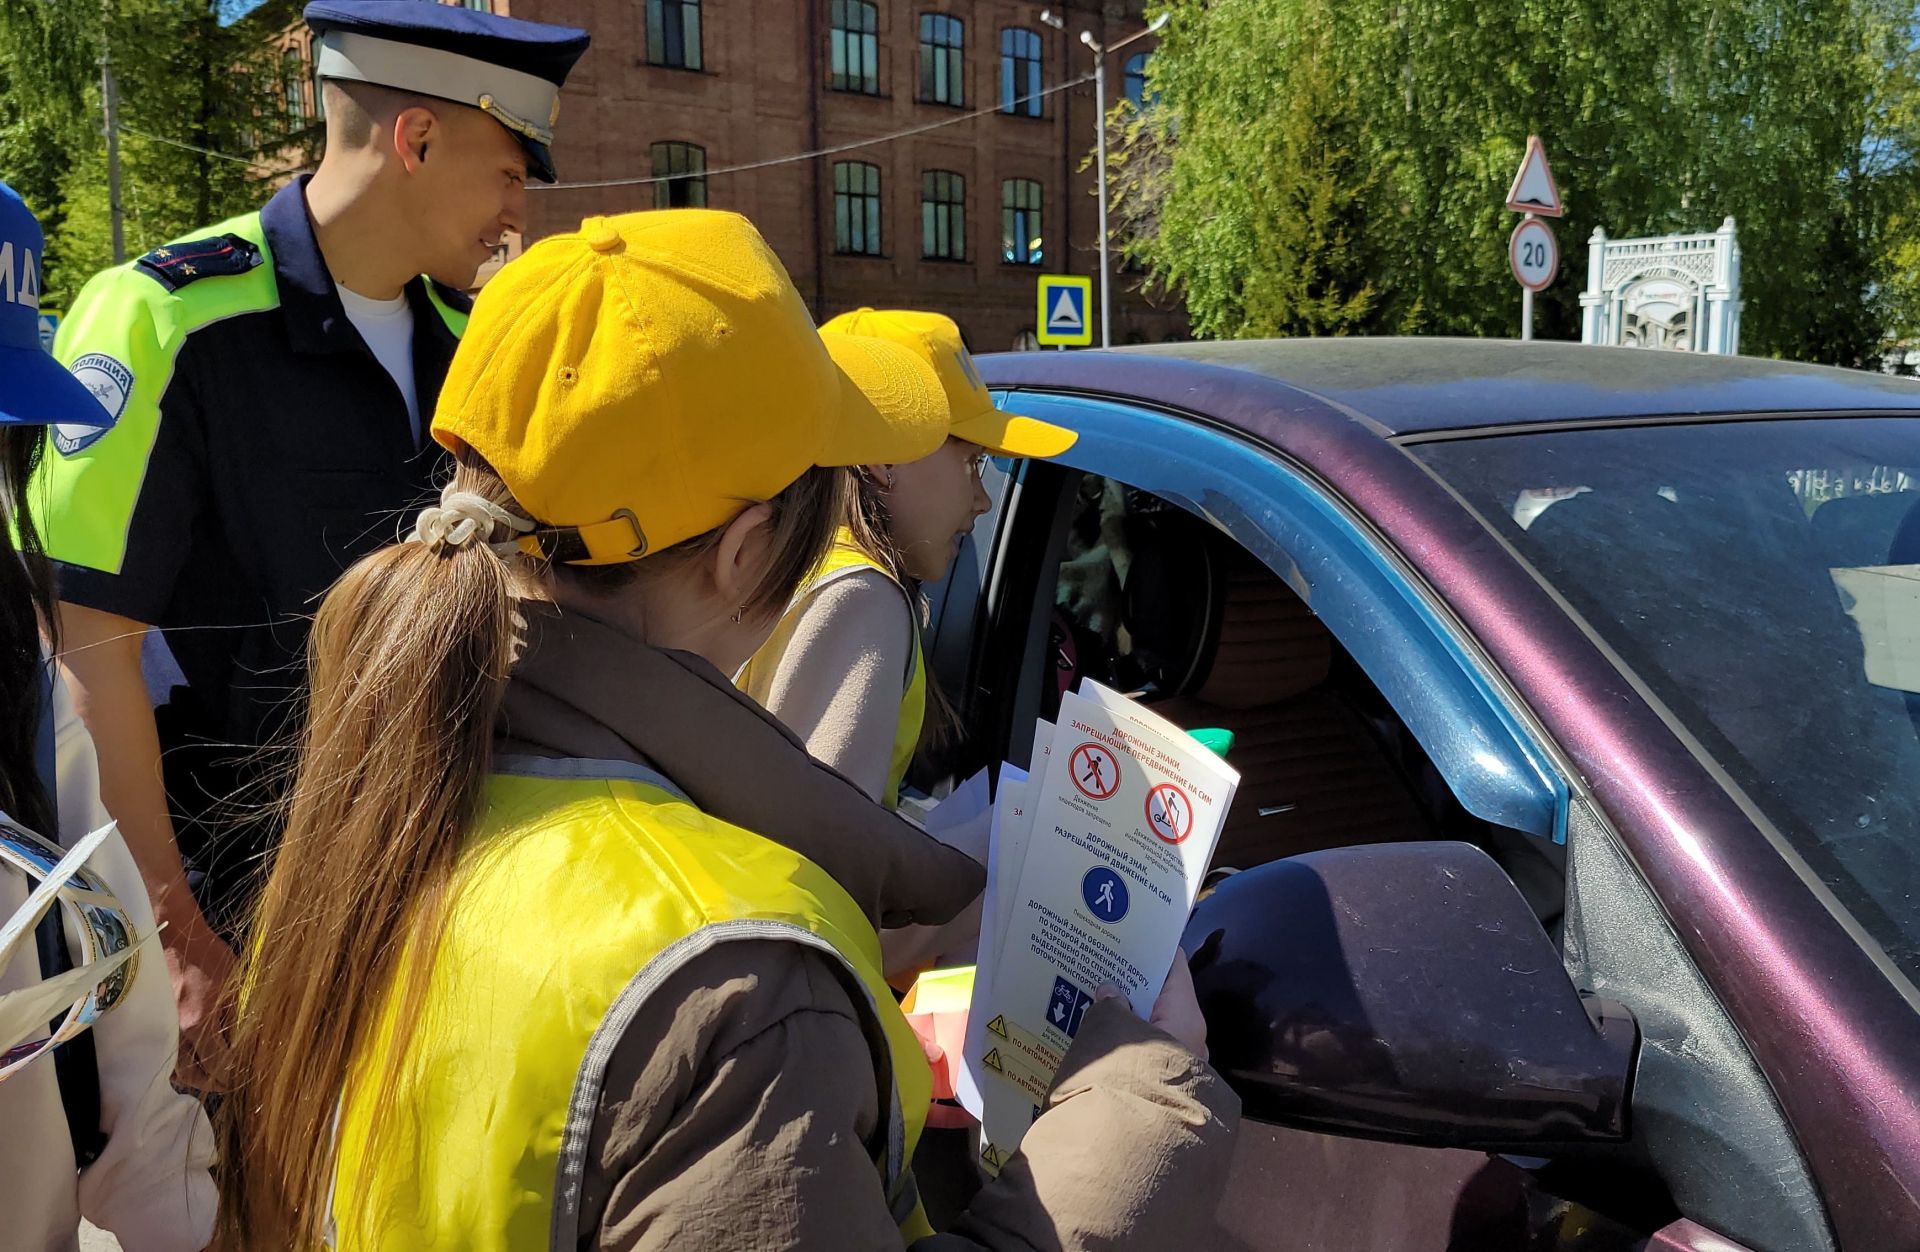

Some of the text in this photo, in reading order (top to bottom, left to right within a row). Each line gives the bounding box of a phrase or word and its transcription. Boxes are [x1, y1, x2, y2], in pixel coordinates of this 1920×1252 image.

[1523, 242, 1545, 268] 20
[71, 358, 128, 387] ПОЛИЦИЯ
[56, 432, 81, 452] МВД
[1112, 728, 1155, 754] ДОРОЖНЫЕ
[1071, 720, 1132, 754] ЗАПРЕЩАЮЩИЕ
[1132, 750, 1188, 787] ПЕРЕДВИЖЕНИЕ
[1188, 782, 1198, 796] НА
[1198, 790, 1212, 806] СИМ
[1054, 826, 1172, 904] РАЗРЕШАЮЩИЙ ДВИЖЕНИЕ НА СИМ
[1086, 832, 1148, 876] ДОРОЖНЫЙ ЗНАК,
[1028, 899, 1150, 990] ДОРОЖНЫЙ ЗНАК ОБОЗНАЧАЕТ ДОРОГУ,
[1030, 933, 1076, 968] ВЫДЕЛЕННОЙ
[1030, 944, 1056, 964] ПОТОКУ
[1038, 916, 1138, 990] ПО КОТОРОЙ ДВИЖЕНИЕ НА СИМ
[1041, 928, 1131, 996] РАЗРЕШЕНО ПО СПЕЦИАЛЬНО
[1012, 1038, 1022, 1048] ПО
[1007, 1070, 1016, 1080] ПО
